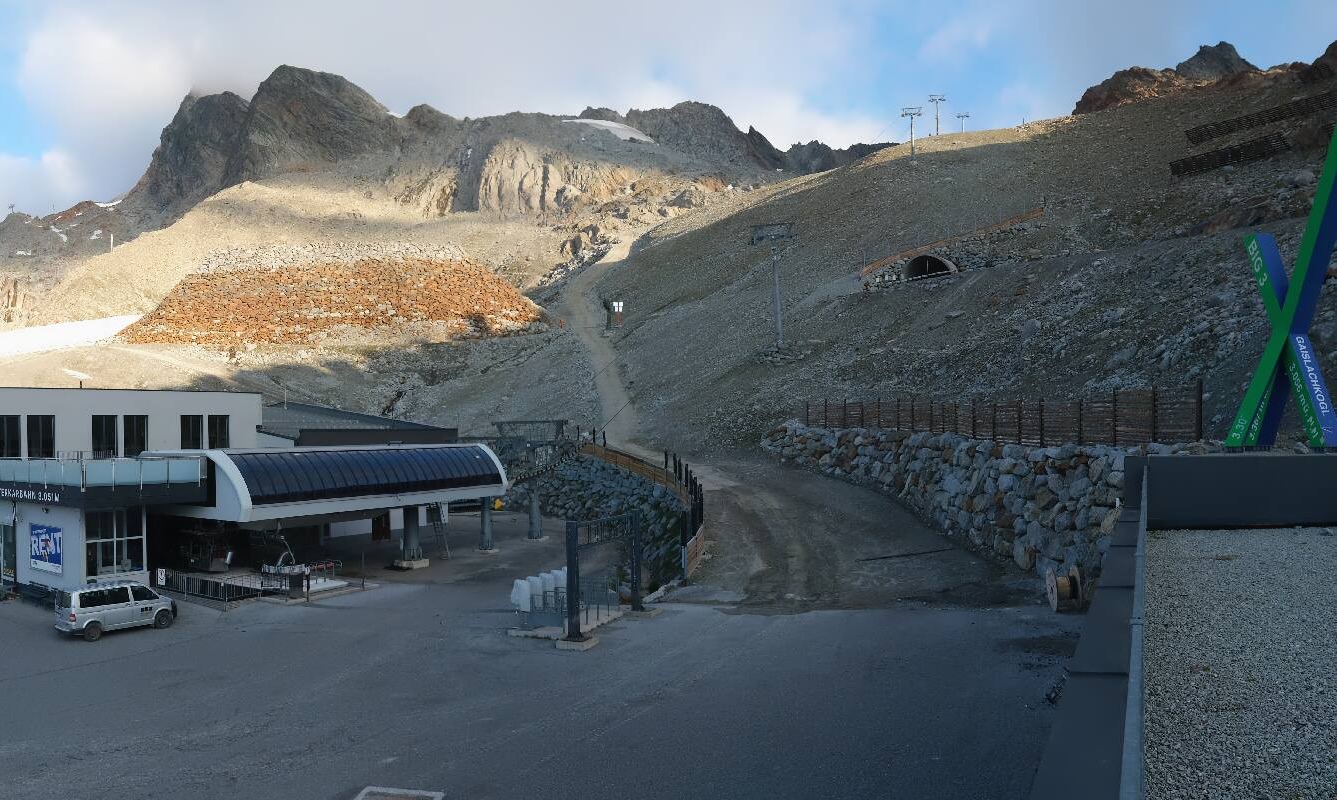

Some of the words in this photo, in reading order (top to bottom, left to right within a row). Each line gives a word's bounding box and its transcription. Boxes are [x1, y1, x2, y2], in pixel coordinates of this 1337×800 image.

[1248, 239, 1263, 272] BIG
[1259, 273, 1268, 287] 3
[1295, 336, 1330, 417] GAISLACHKOGL
[31, 531, 62, 556] RENT
